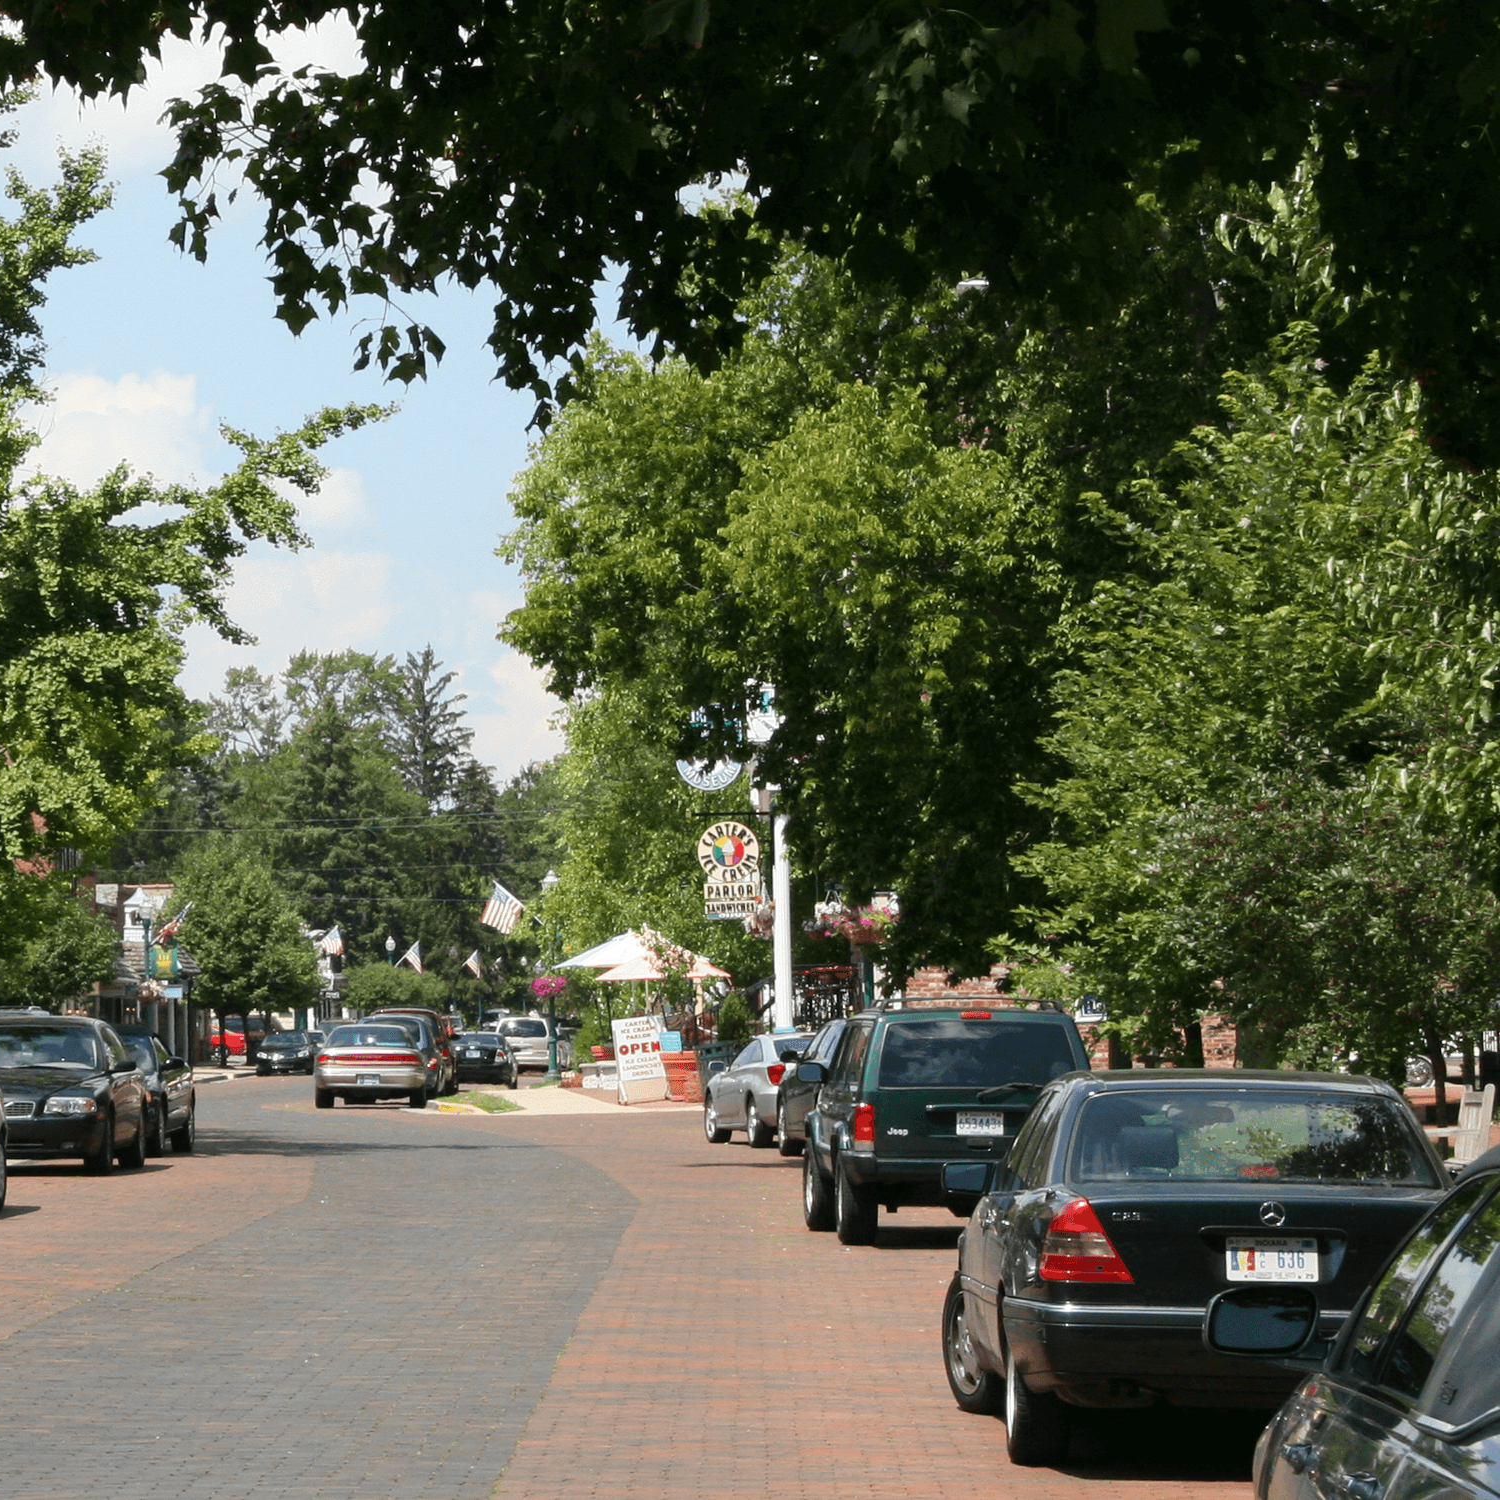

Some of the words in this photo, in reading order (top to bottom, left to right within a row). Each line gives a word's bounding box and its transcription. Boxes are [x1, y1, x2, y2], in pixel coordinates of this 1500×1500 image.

[683, 763, 737, 788] MUSEUM
[702, 822, 755, 847] CARTER'S
[700, 853, 719, 875] ICE
[721, 853, 758, 882] CREAM
[706, 884, 754, 898] PARLOR
[619, 1041, 660, 1056] OPEN
[886, 1127, 909, 1137] Jeep
[1254, 1239, 1288, 1247] INDIANA
[1277, 1249, 1305, 1269] 636
